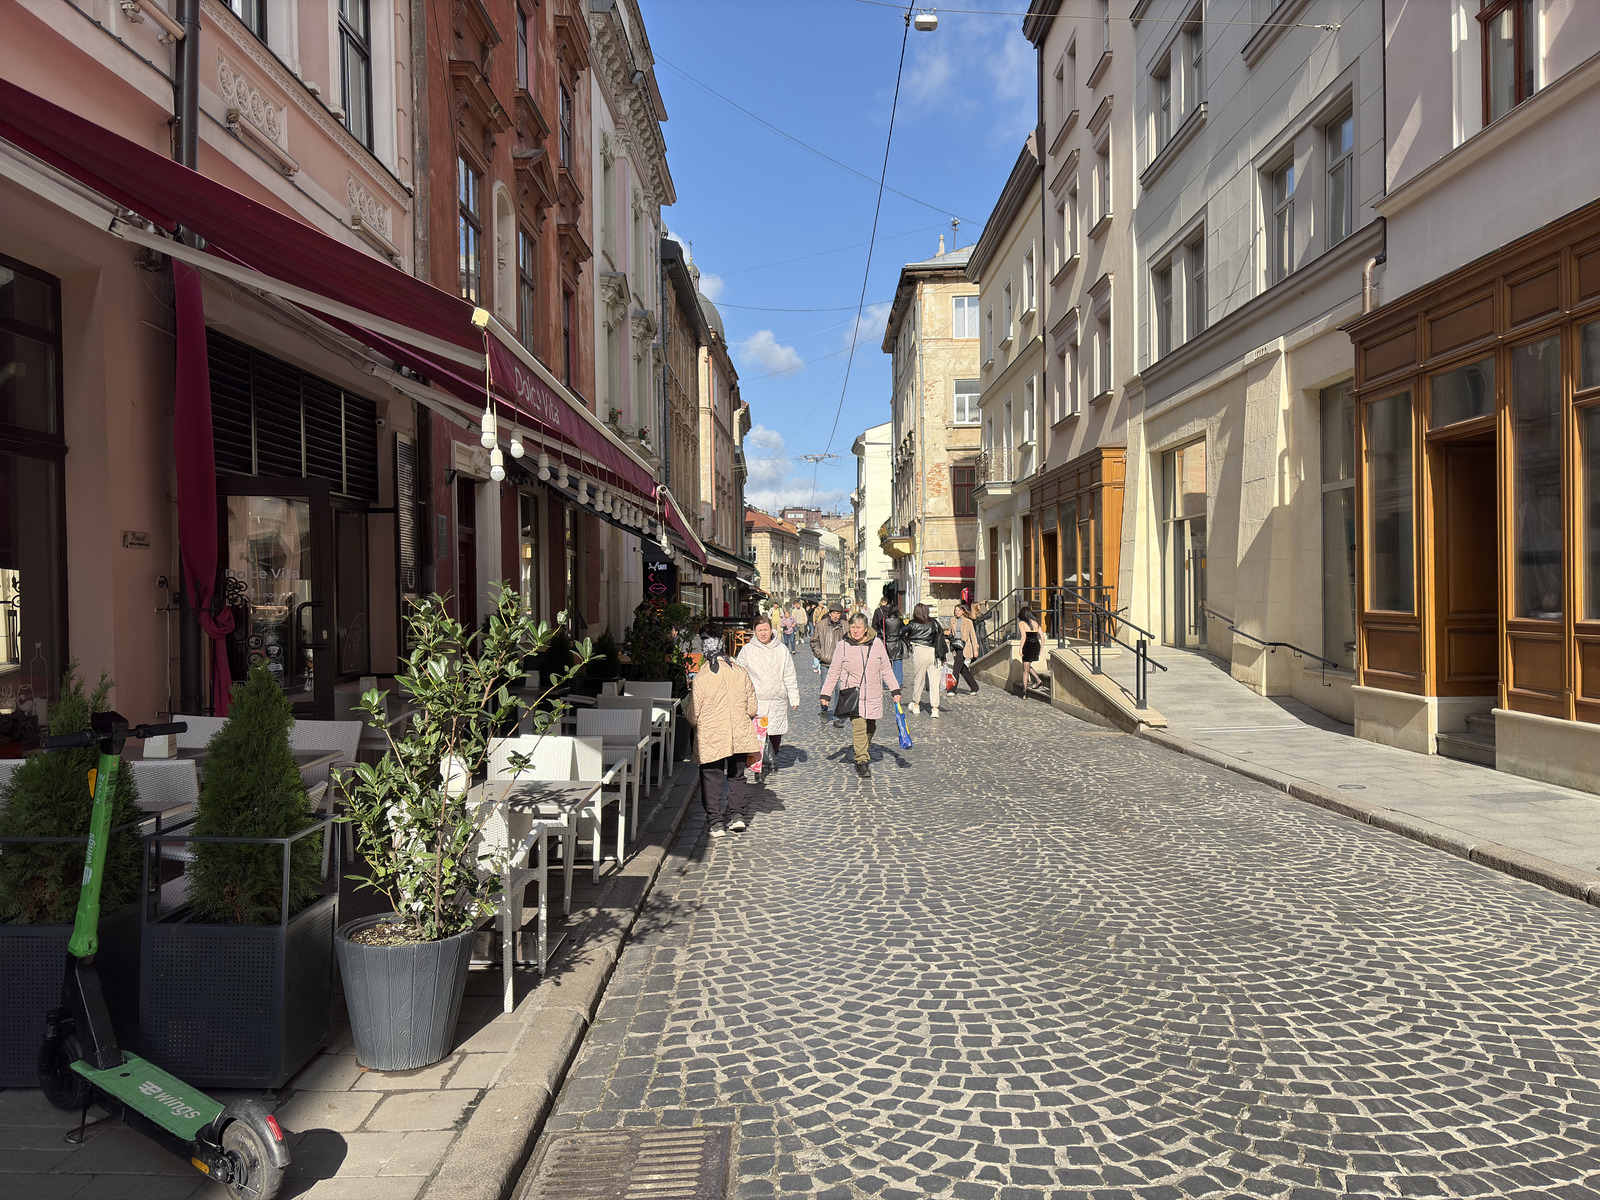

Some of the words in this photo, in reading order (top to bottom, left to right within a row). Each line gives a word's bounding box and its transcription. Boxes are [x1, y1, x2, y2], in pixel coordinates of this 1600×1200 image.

[514, 366, 542, 411] Dolce
[541, 389, 561, 426] Vita
[270, 567, 300, 579] Vita
[86, 833, 96, 864] wings
[153, 1092, 201, 1119] wings
